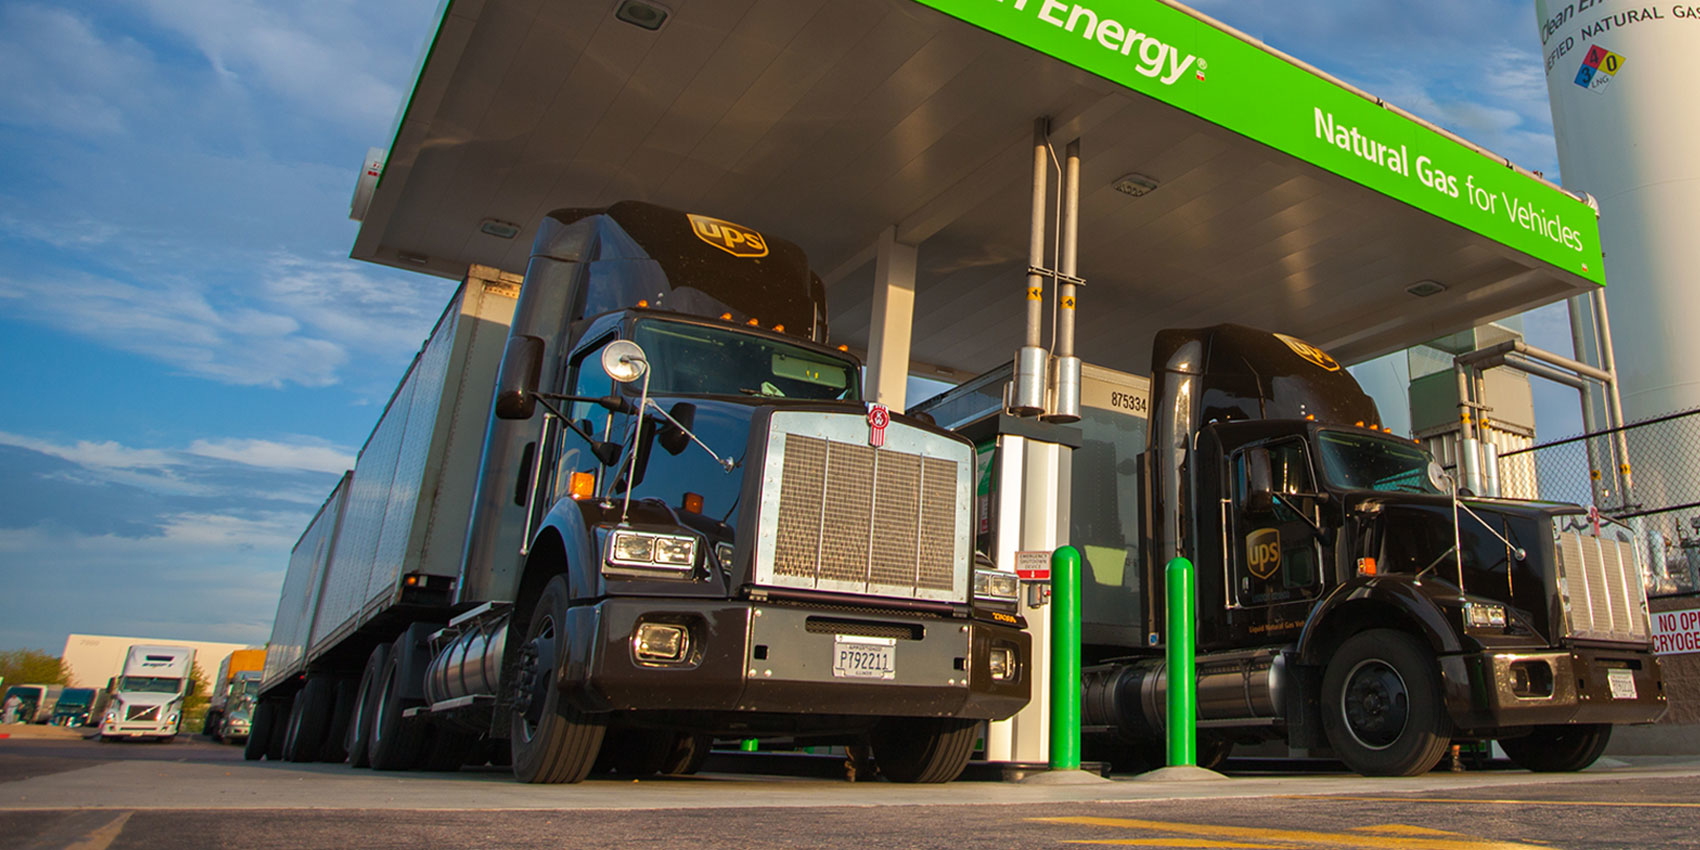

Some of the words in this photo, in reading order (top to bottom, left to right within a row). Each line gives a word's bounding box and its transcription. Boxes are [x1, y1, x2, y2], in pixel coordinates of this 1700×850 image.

[1541, 3, 1575, 46] Clean
[1545, 36, 1574, 76] EFIED
[1581, 6, 1664, 41] NATURAL
[1672, 5, 1700, 19] GAS
[1589, 48, 1599, 64] 4
[1582, 67, 1591, 84] 3
[1606, 55, 1617, 72] 0
[1591, 75, 1609, 88] LNG
[1313, 107, 1409, 177] Natural
[1415, 154, 1459, 198] Gas
[1465, 174, 1497, 214] for
[1502, 191, 1583, 252] Vehicles
[696, 221, 764, 250] ups
[1111, 391, 1147, 413] 875334
[1249, 542, 1279, 572] ups
[1658, 613, 1676, 632] NO
[1652, 632, 1700, 652] CRYOGE
[841, 651, 888, 670] P792211
